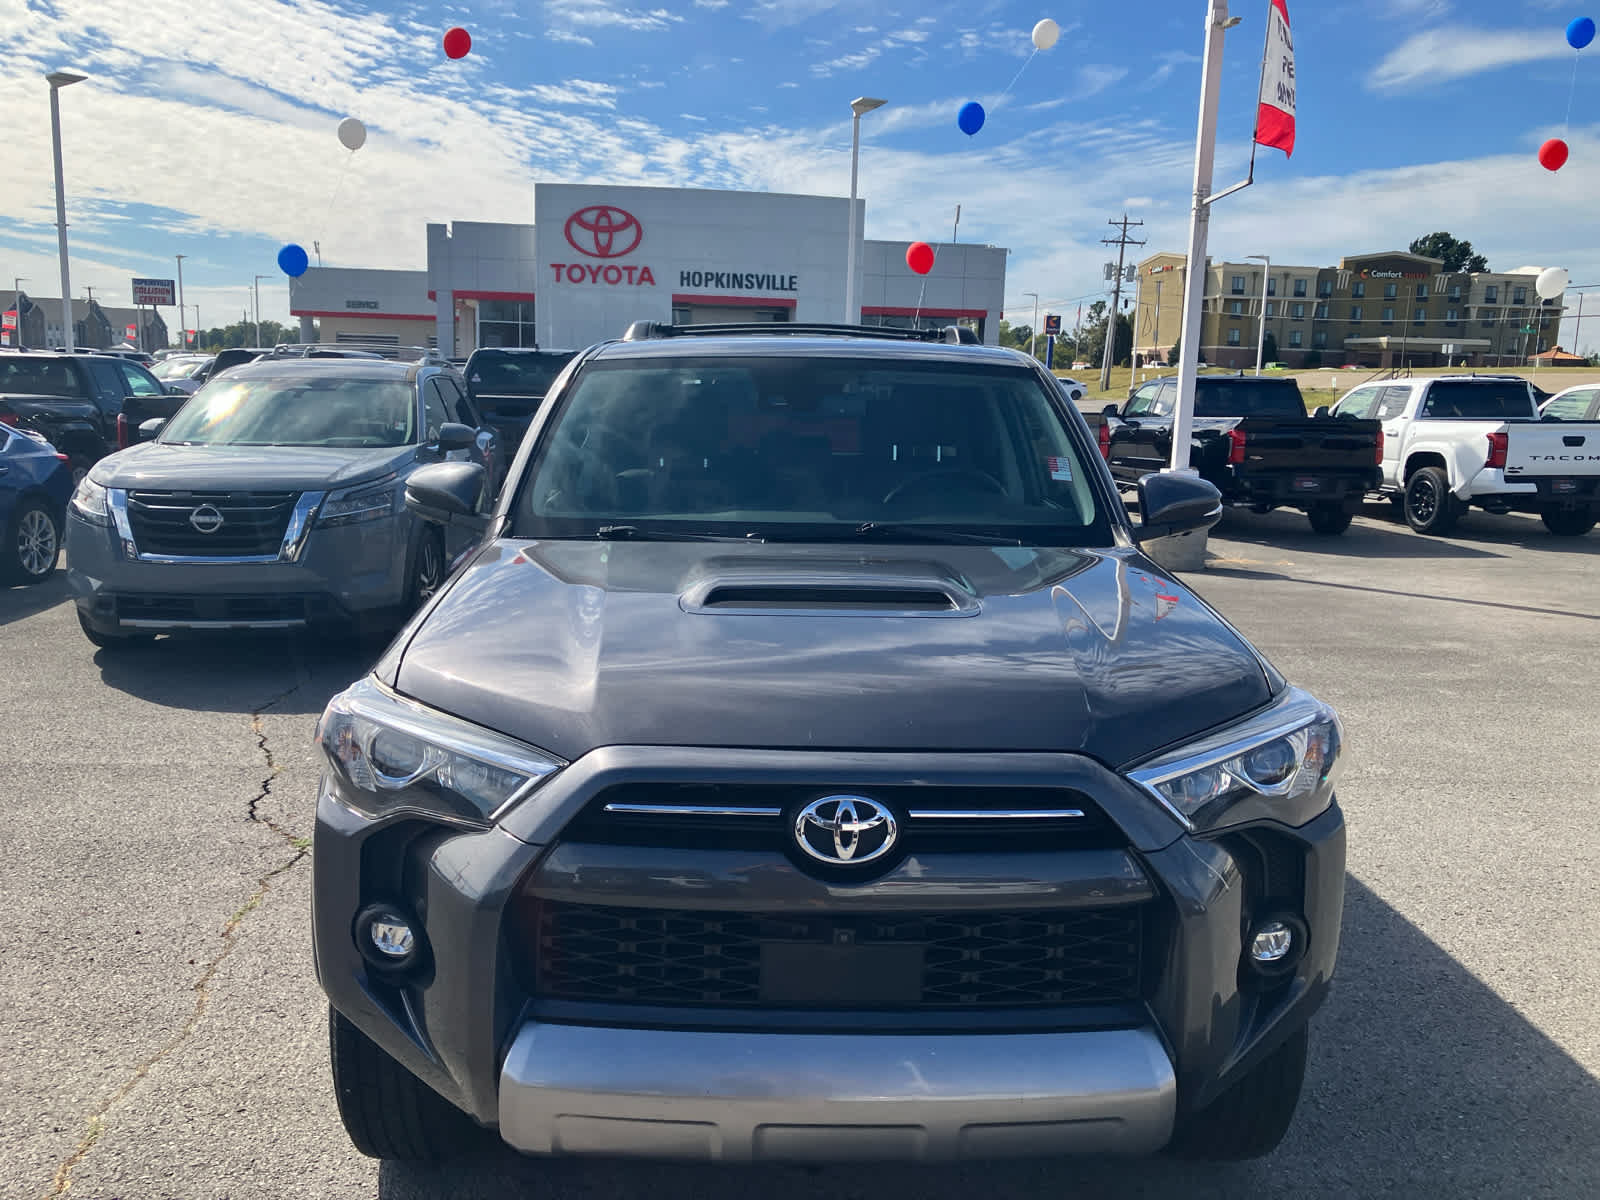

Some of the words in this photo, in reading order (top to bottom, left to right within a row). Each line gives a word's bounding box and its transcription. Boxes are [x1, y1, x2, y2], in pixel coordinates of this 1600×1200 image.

[550, 263, 656, 286] TOYOTA
[680, 270, 798, 291] HOPKINSVILLE
[1371, 270, 1402, 278] Comfort
[134, 286, 170, 296] COLLISION
